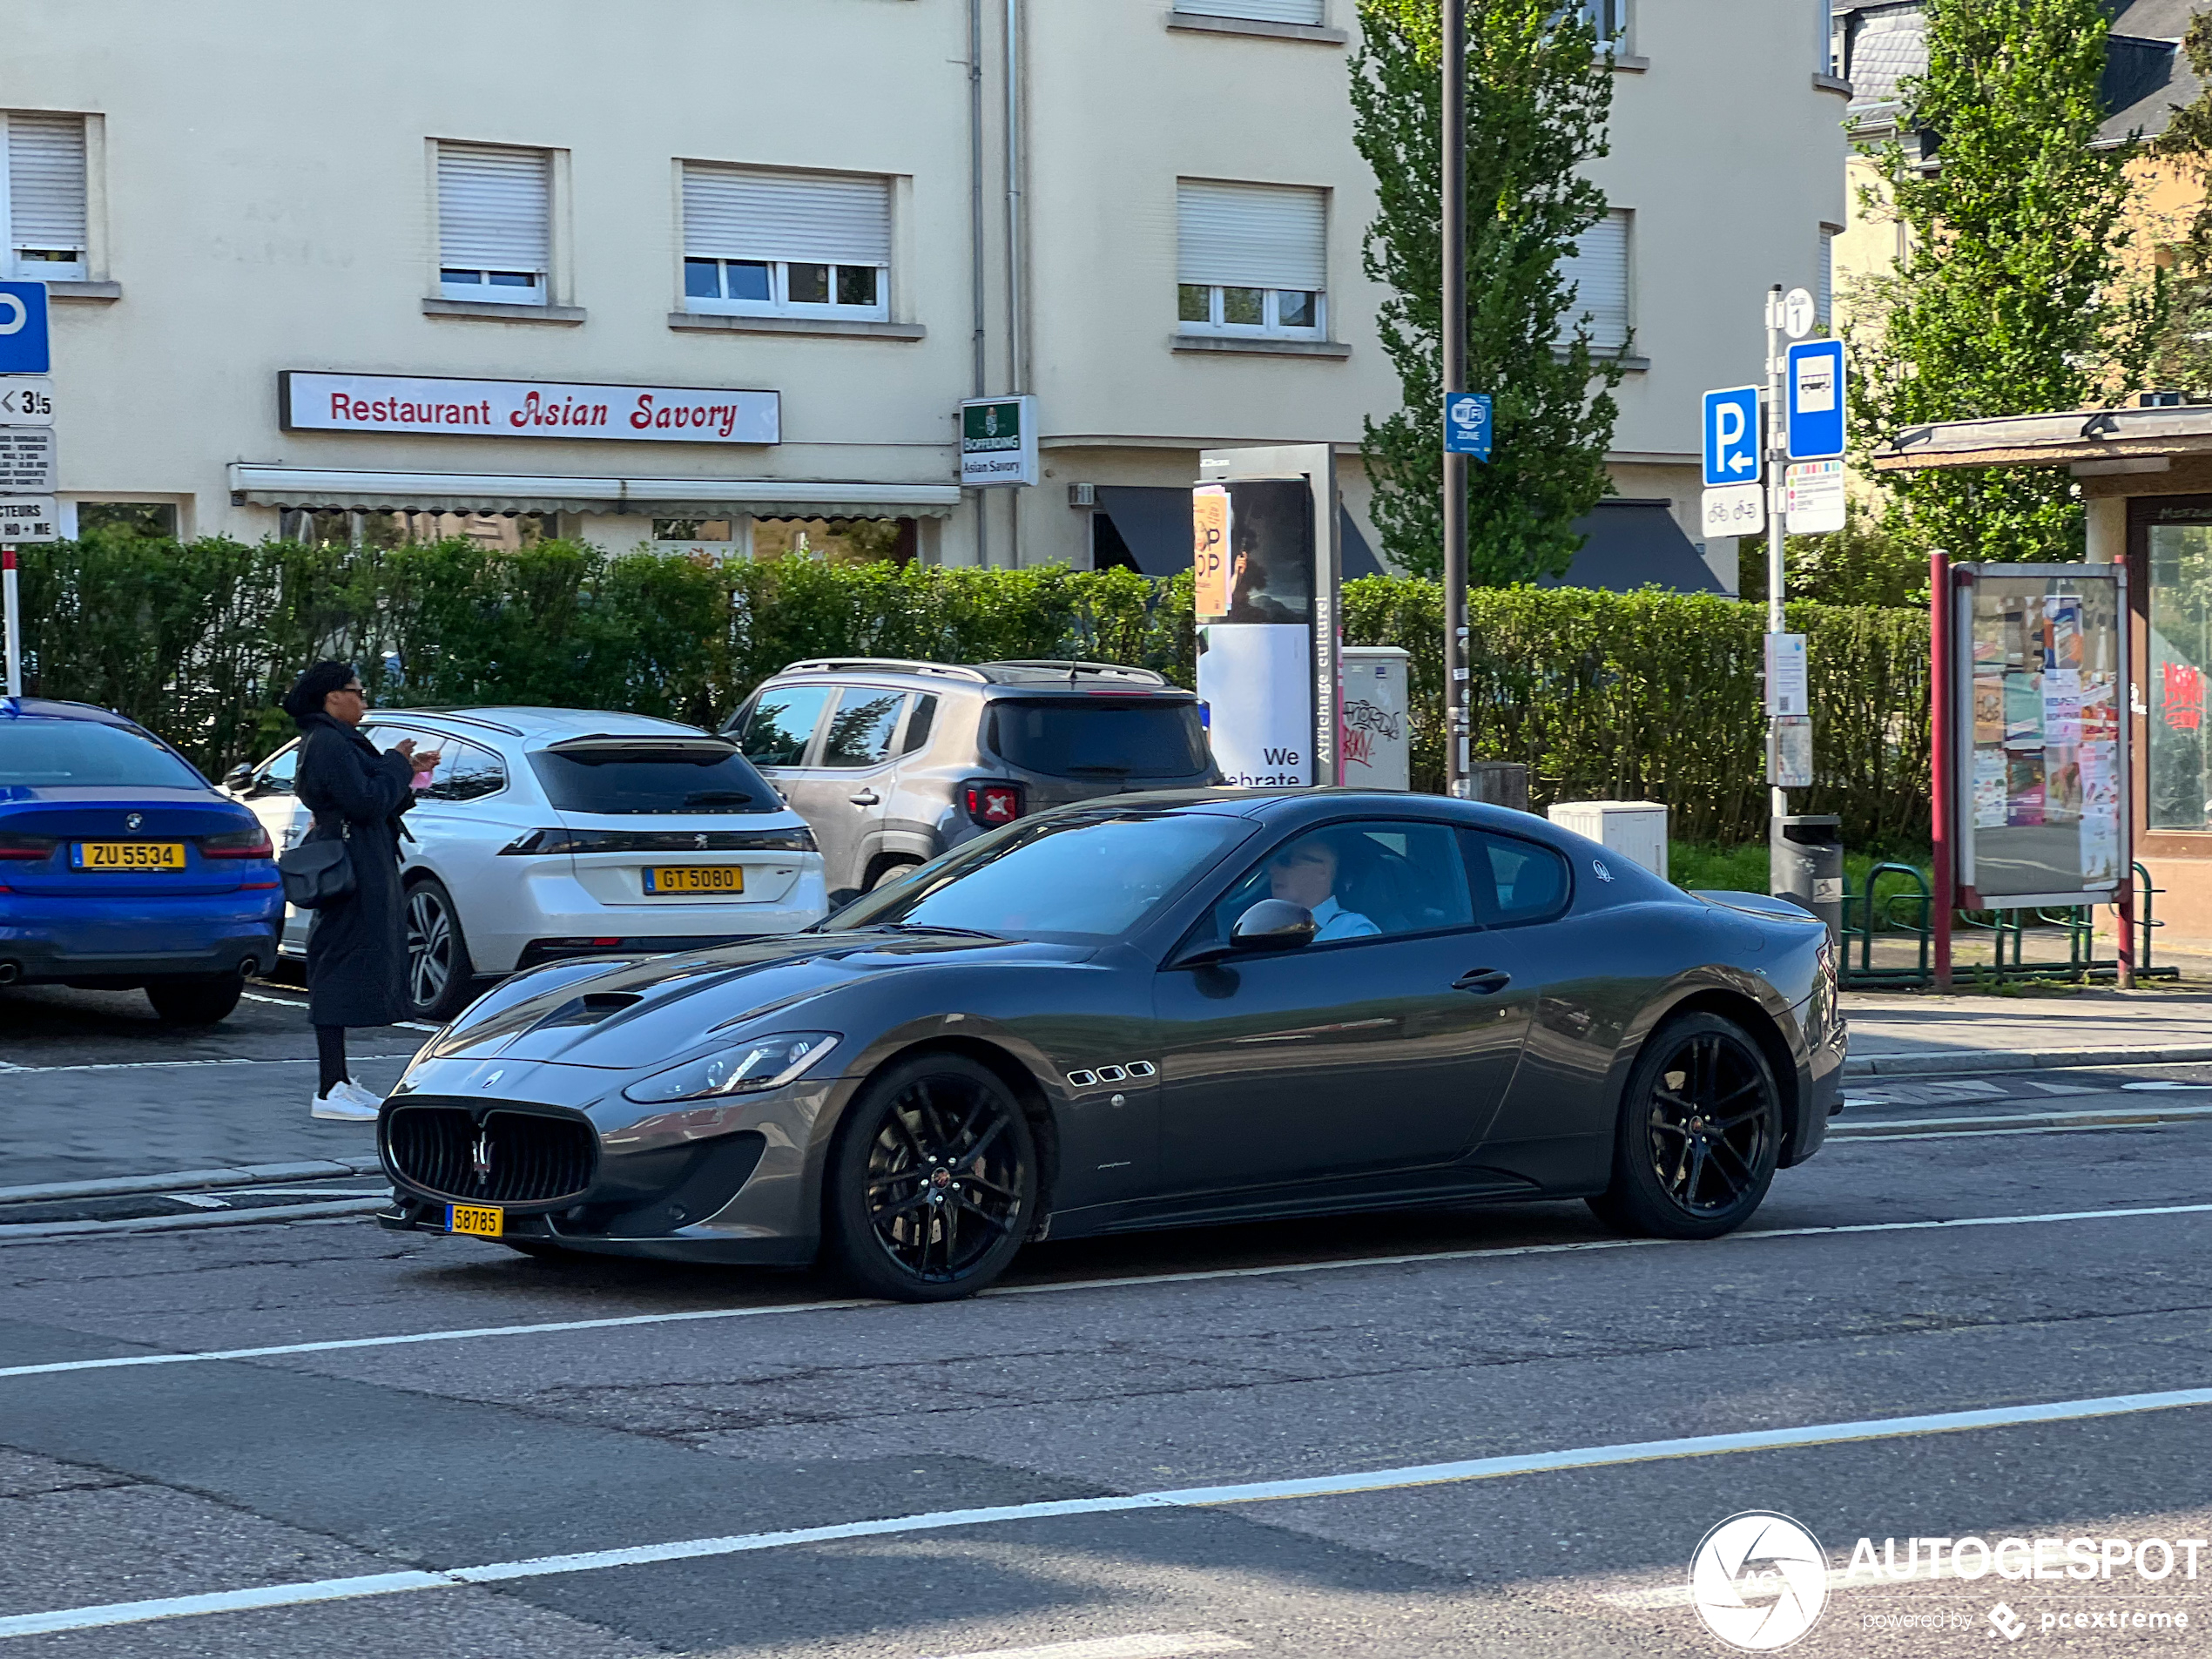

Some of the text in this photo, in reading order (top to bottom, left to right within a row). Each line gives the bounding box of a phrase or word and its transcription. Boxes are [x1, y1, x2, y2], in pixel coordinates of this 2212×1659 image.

[1793, 308, 1800, 333] 1
[330, 390, 738, 437] Restaurant Asian Savory
[1716, 401, 1746, 473] P
[1264, 748, 1299, 765] We
[93, 846, 118, 865] ZU
[123, 846, 173, 865] 5534
[664, 871, 685, 887] GT
[691, 870, 733, 887] 5080
[455, 1210, 496, 1231] 58785
